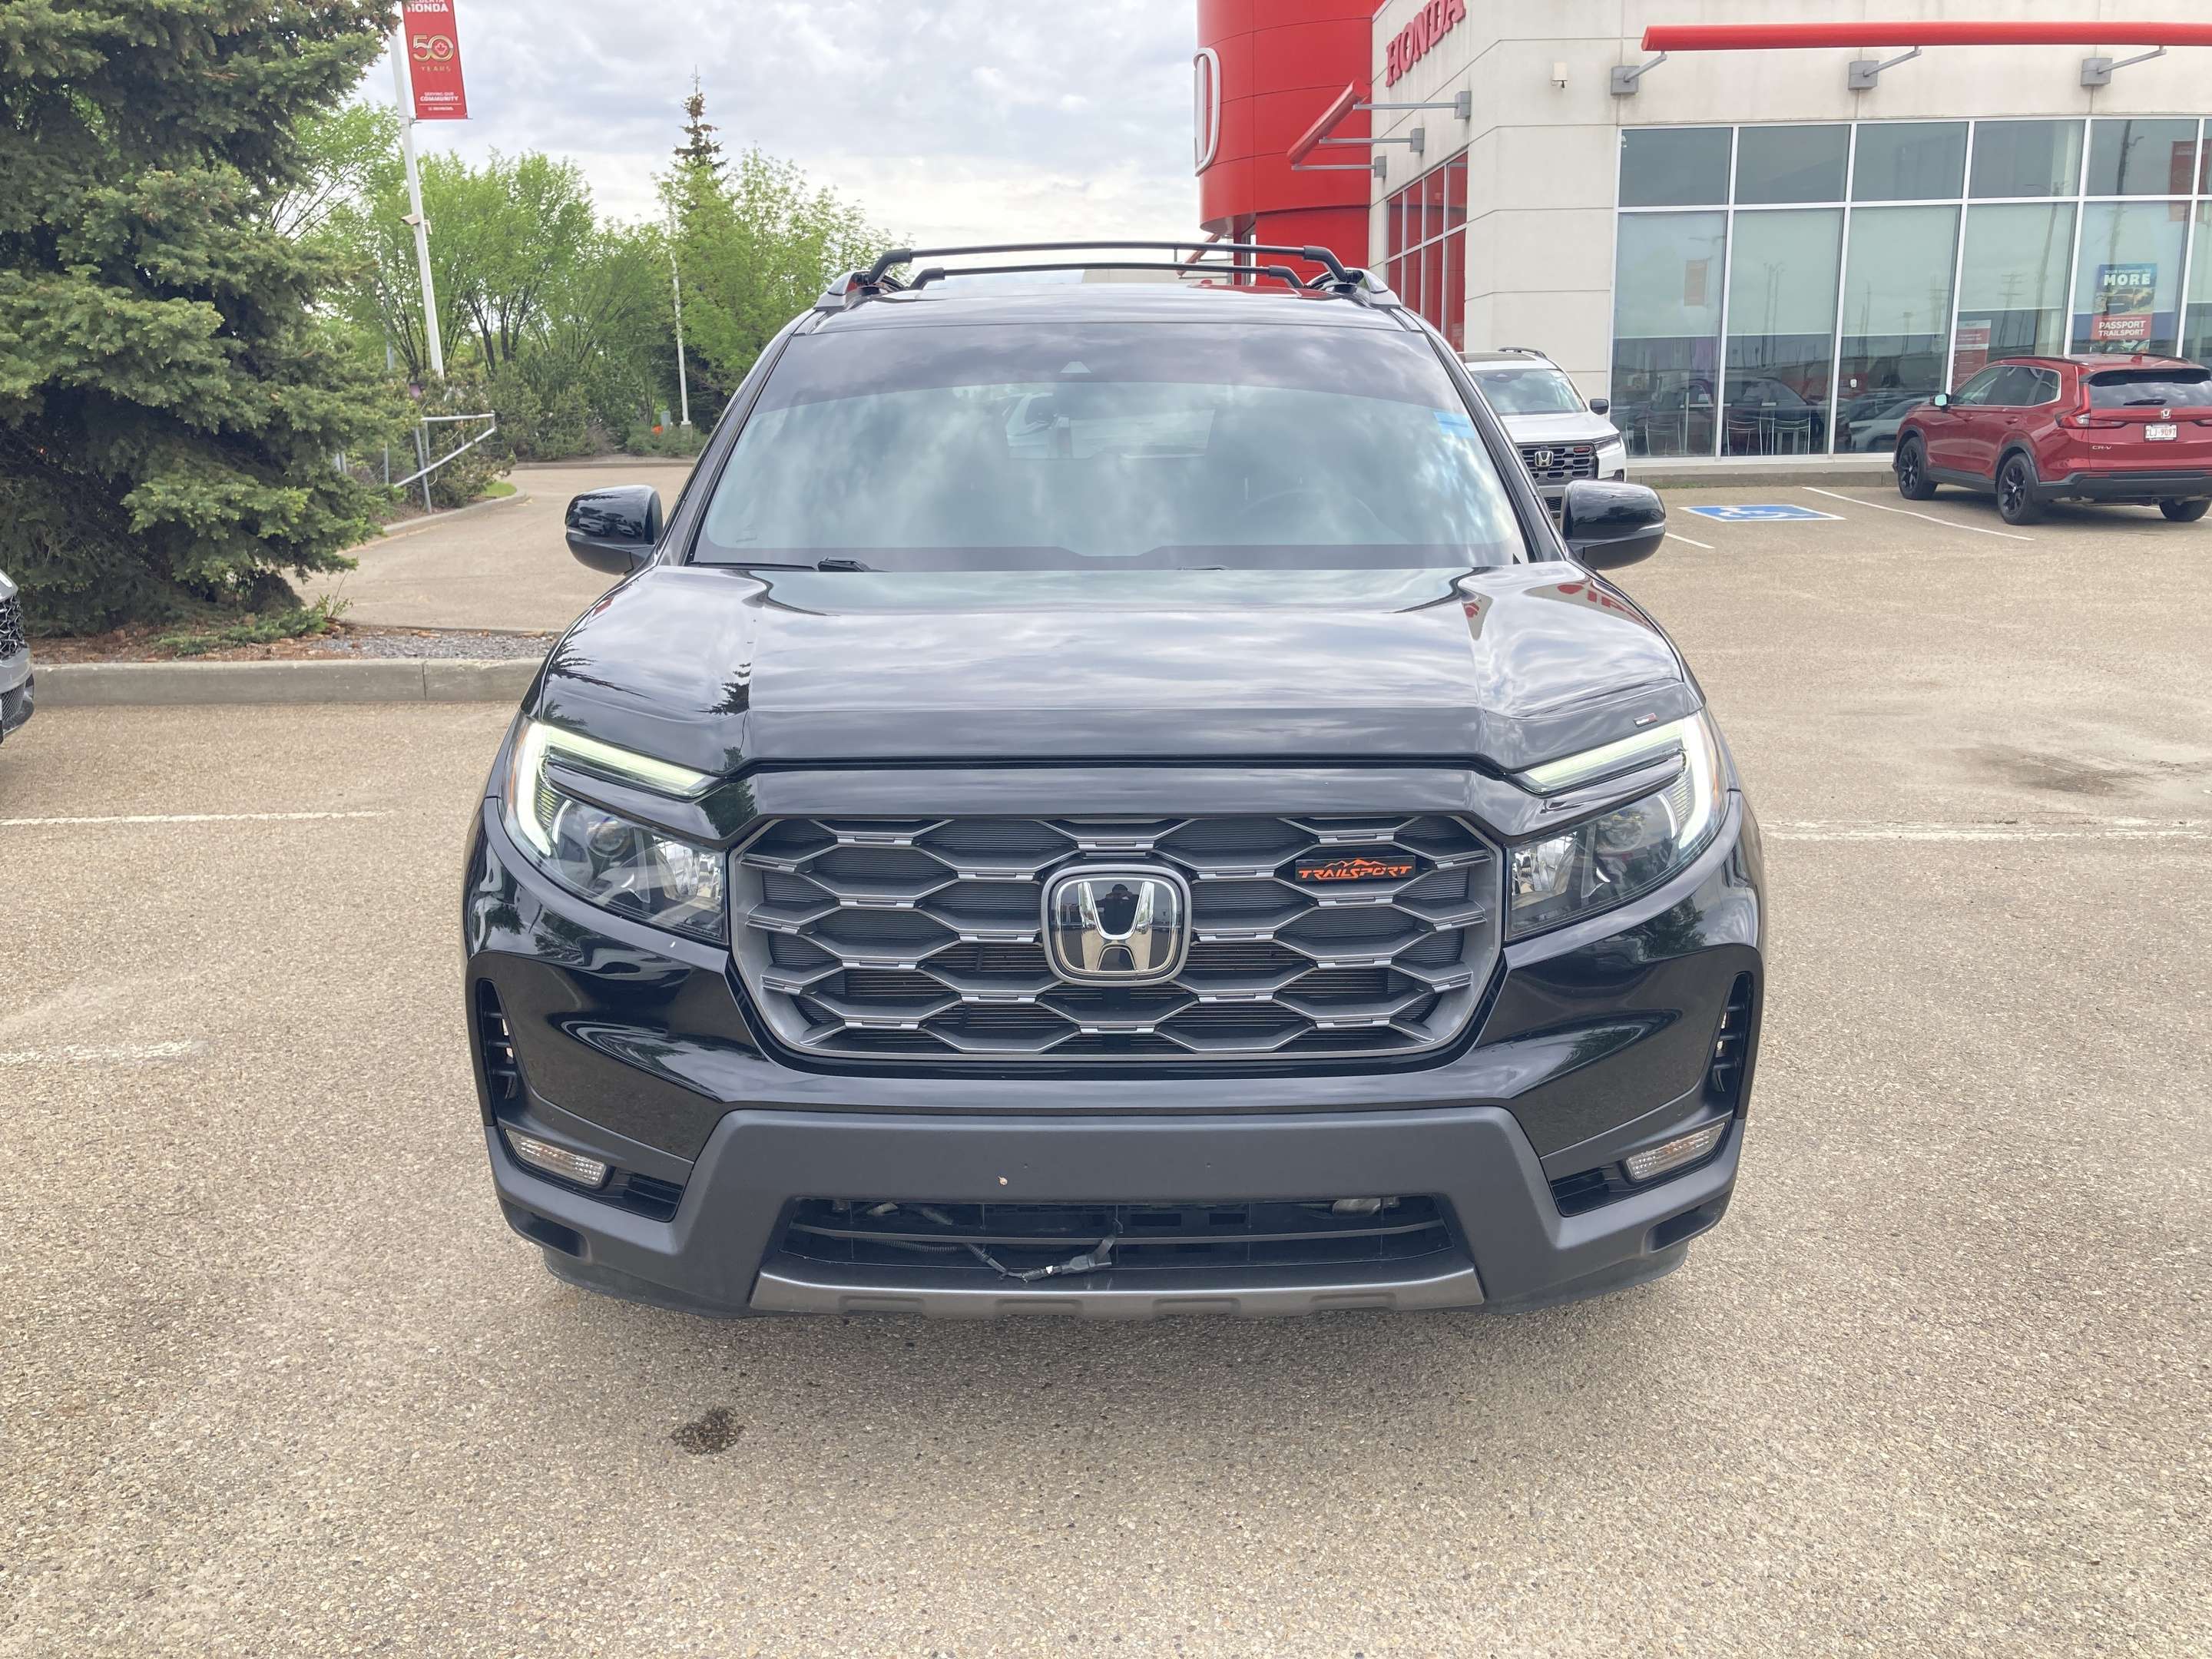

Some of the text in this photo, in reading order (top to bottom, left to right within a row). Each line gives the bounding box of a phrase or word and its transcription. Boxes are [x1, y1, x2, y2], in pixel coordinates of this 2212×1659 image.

[412, 35, 454, 61] 50
[1386, 0, 1466, 88] HONDA
[2104, 273, 2151, 286] MORE
[2098, 320, 2147, 329] PASSPORT
[1298, 866, 1413, 880] TRAILSPORT
